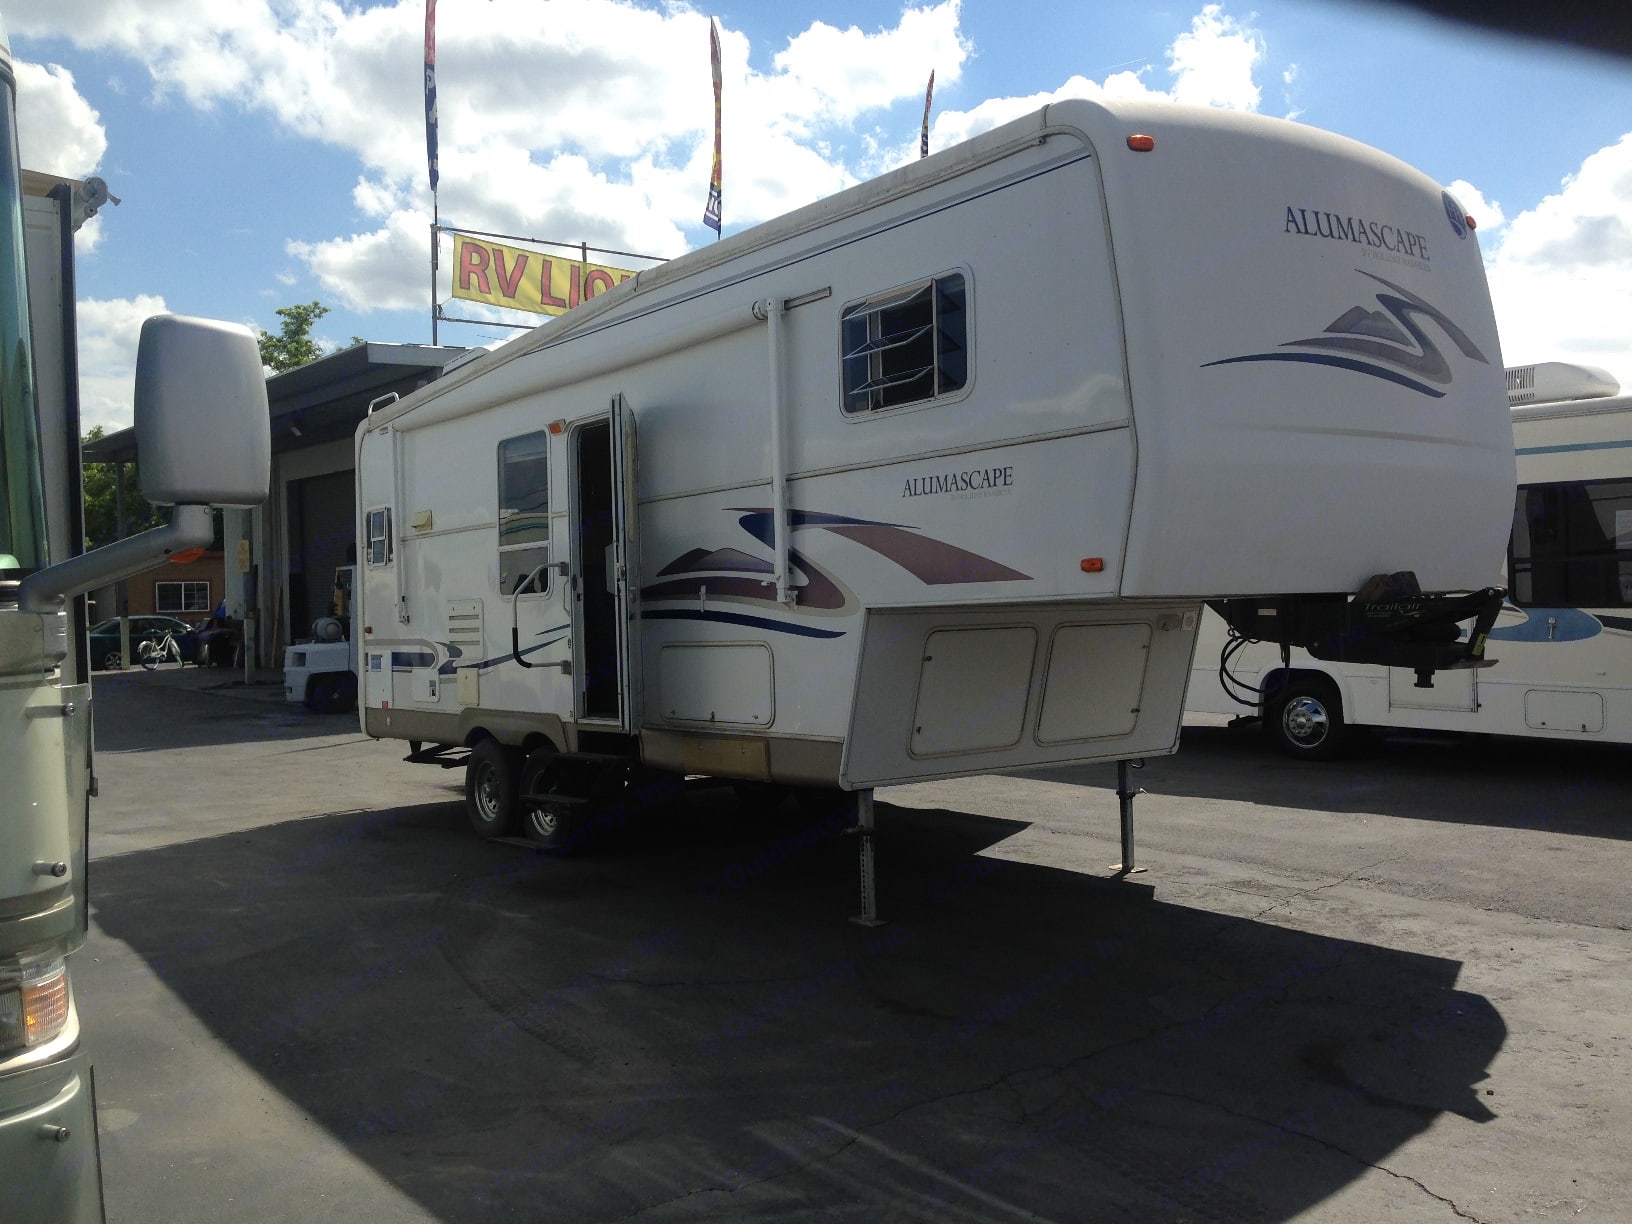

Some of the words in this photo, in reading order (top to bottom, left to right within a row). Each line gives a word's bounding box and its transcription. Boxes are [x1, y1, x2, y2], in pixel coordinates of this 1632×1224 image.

[1284, 206, 1431, 261] ALUMASCAPE
[460, 241, 529, 298] RV
[902, 466, 1013, 498] ALUMASCAPE
